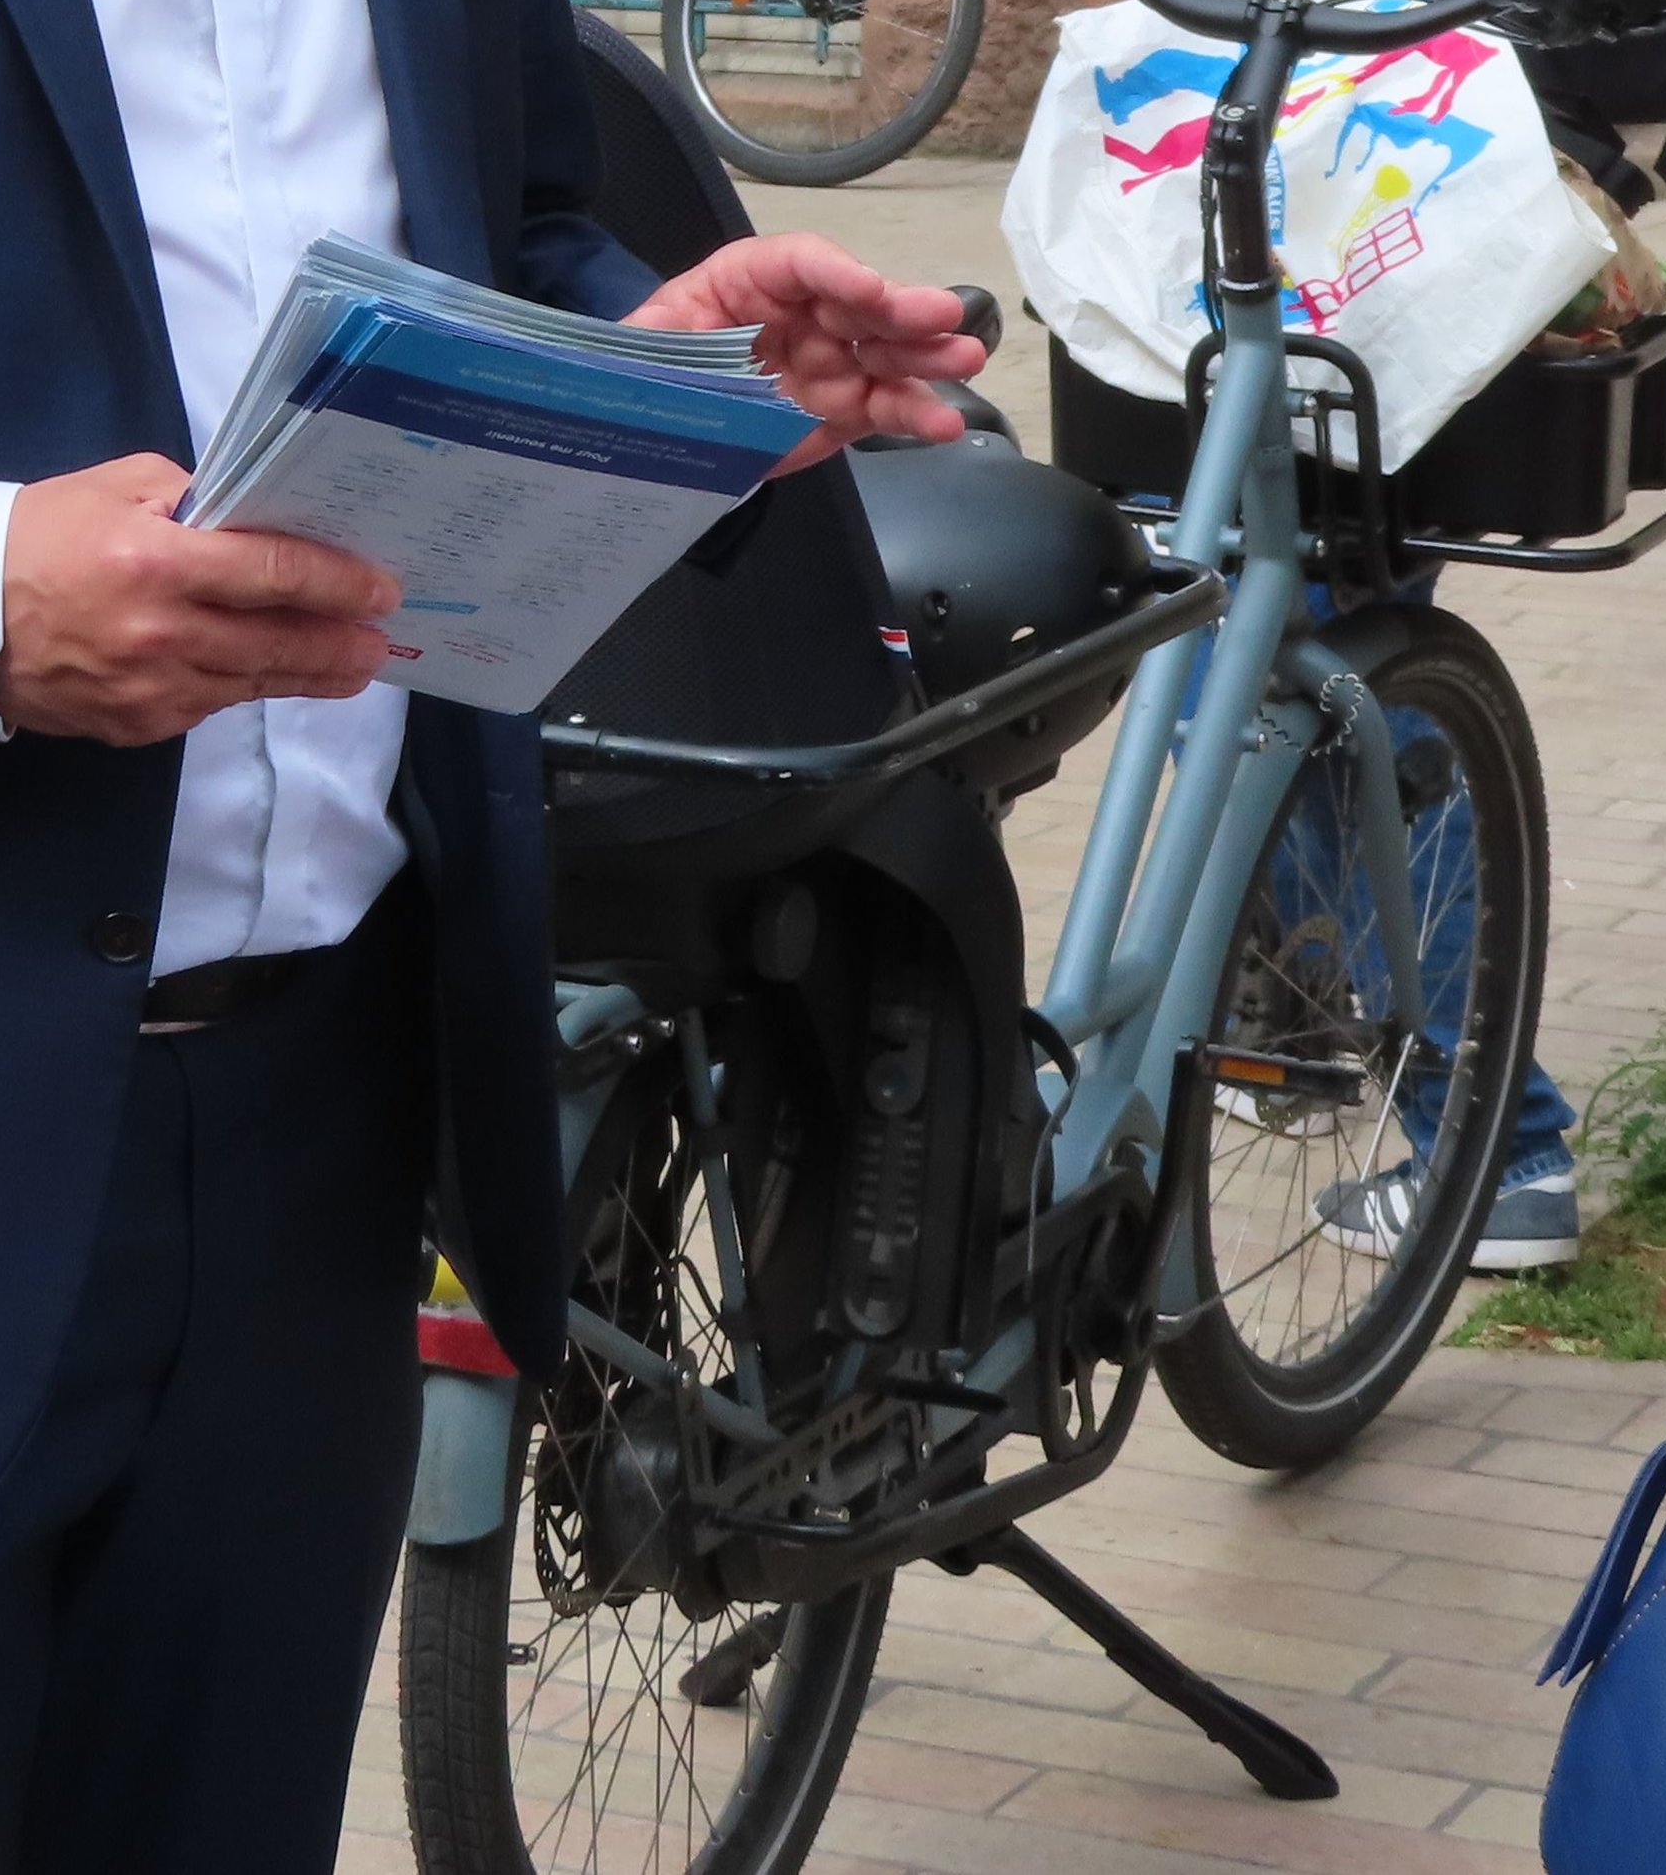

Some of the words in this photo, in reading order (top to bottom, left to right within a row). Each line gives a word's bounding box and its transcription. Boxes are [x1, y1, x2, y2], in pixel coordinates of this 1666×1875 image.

[484, 429, 546, 449] soutenir
[550, 443, 574, 455] me
[576, 449, 612, 463] Pour
